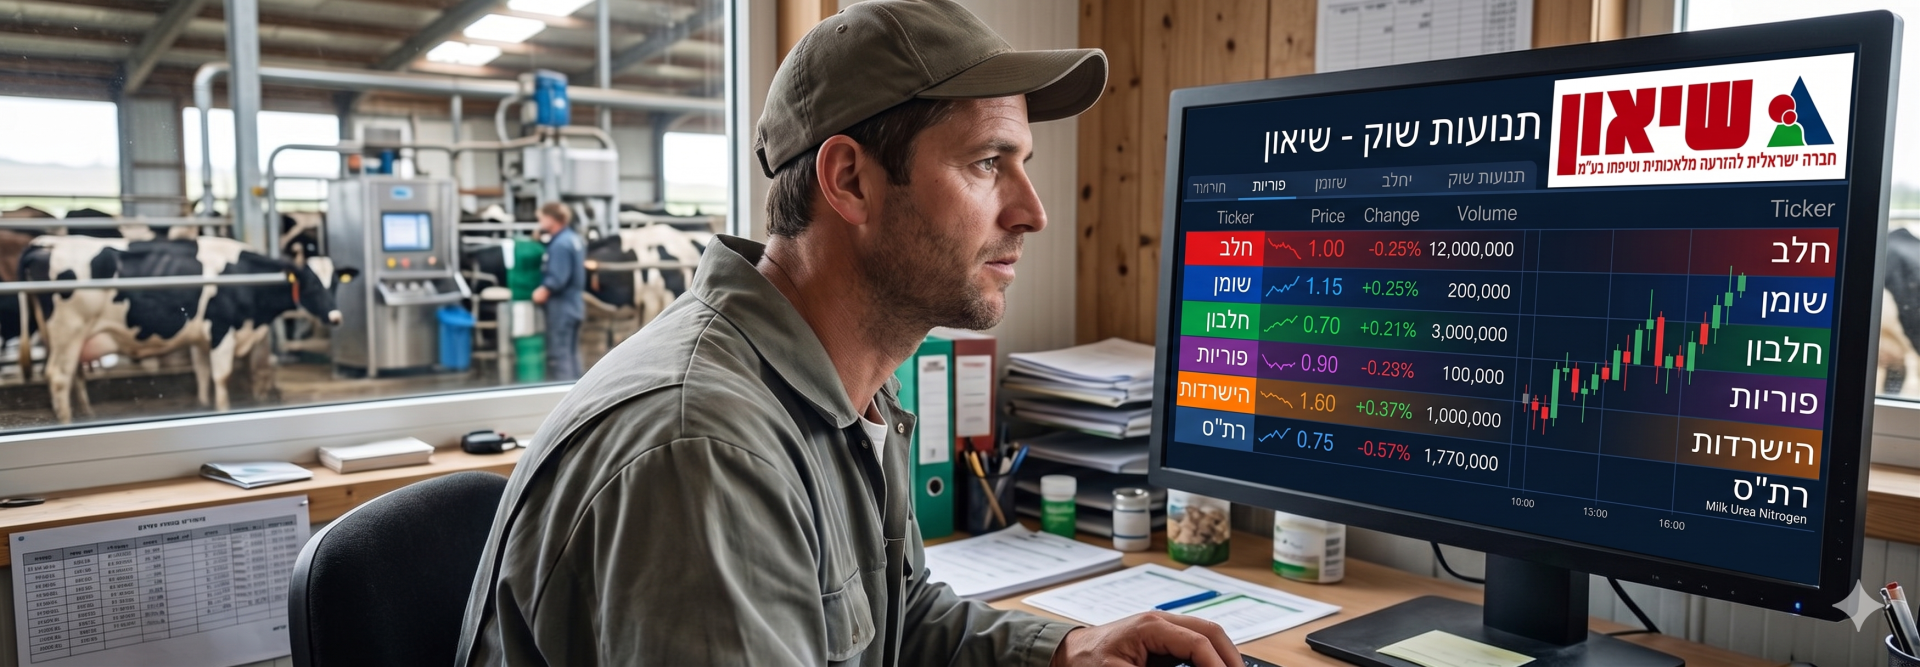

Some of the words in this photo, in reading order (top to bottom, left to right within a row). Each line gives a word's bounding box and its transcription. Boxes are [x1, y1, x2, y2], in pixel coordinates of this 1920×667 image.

[1430, 112, 1540, 146] תנועות
[1557, 79, 1753, 175] שיאון
[1265, 127, 1330, 163] שיאון
[1364, 121, 1419, 157] שוק
[1643, 156, 1696, 172] מלאכותית
[1700, 153, 1743, 170] להזרעה
[1747, 152, 1798, 168] ישראלית
[1803, 153, 1836, 166] חברה
[1253, 180, 1285, 191] פוריות
[1449, 173, 1474, 188] שוק
[1478, 171, 1524, 184] תנועות
[1217, 211, 1254, 224] Ticker
[1312, 209, 1345, 223] Price
[1365, 208, 1419, 225] Change
[1458, 206, 1517, 221] Volume
[1771, 199, 1835, 217] Ticker
[1220, 237, 1252, 256] חלב
[1309, 240, 1344, 257] 1.00
[1369, 241, 1421, 256] -0.25%
[1430, 242, 1513, 259] 12,000,000
[1772, 236, 1830, 263] חלב
[1214, 277, 1251, 296] שומן
[1307, 277, 1342, 295] 1.15
[1363, 281, 1418, 296] +0.25%
[1448, 283, 1510, 301] 200,000
[1762, 292, 1827, 318] שומן
[1207, 310, 1249, 332] חלבון
[1304, 316, 1340, 334] 0.70
[1361, 321, 1416, 337] +0.21%
[1432, 324, 1507, 343] 3,000,000
[1197, 348, 1247, 365] פוריות
[1747, 336, 1821, 366] חלבון
[1302, 354, 1337, 373] 0.90
[1361, 360, 1414, 378] -0.23%
[1444, 366, 1504, 385] 100,000
[1179, 381, 1249, 404] הישרדות
[1301, 392, 1335, 412] 1.60
[1730, 388, 1817, 414] פוריות
[1356, 400, 1412, 419] +0.37%
[1427, 407, 1501, 427] 1,000,000
[1203, 418, 1245, 440] רת"ס
[1298, 430, 1333, 451] 0.75
[1692, 433, 1813, 465] הישרדות
[1358, 441, 1410, 460] -0.57%
[1425, 449, 1498, 471] 1,770,000
[1734, 476, 1808, 508] רת"ס
[1512, 498, 1534, 507] 10:00
[1706, 501, 1727, 513] Milk
[1731, 504, 1755, 516] Urea
[1759, 508, 1807, 524] Nitrogen
[1660, 519, 1685, 530] 16:00
